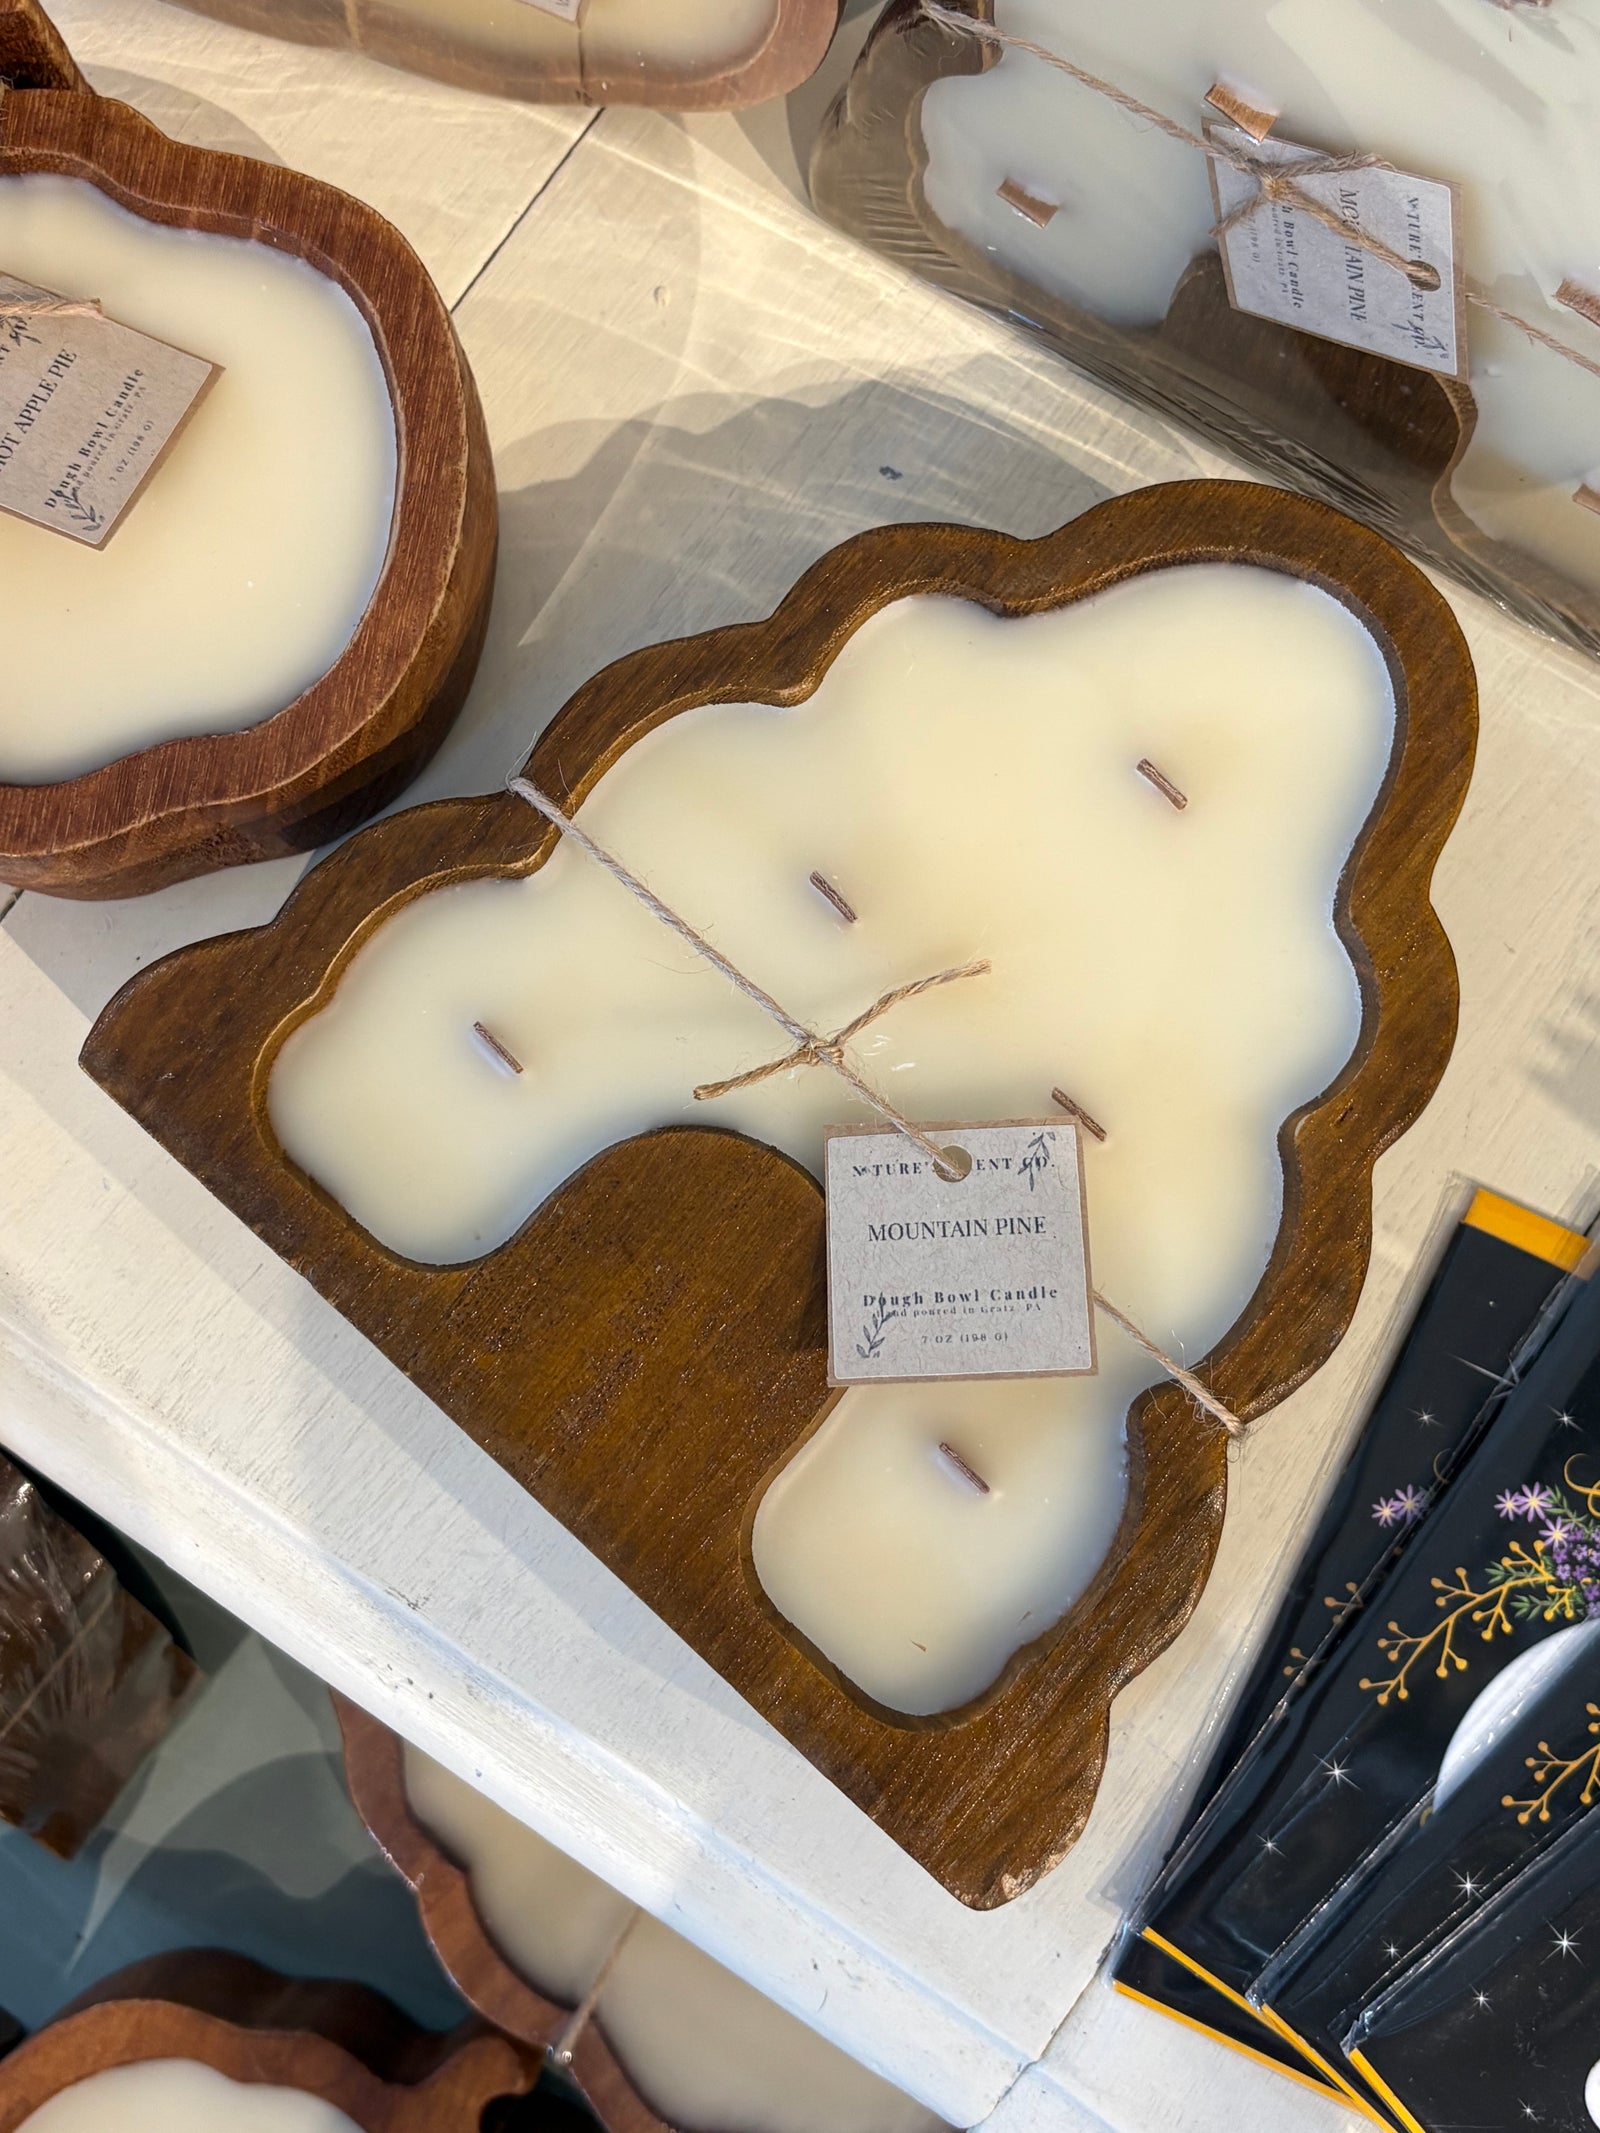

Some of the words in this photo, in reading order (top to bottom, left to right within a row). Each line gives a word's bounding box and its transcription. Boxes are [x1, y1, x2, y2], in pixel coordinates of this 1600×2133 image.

[1288, 262, 1305, 308] Candle
[1348, 285, 1367, 323] PINE
[14, 378, 58, 434] APPLE
[47, 348, 78, 379] PIE
[78, 422, 108, 457] Bowl
[104, 369, 144, 417] Candle
[867, 1218, 988, 1242] MOUNTAIN
[994, 1216, 1047, 1236] PINE
[863, 1291, 924, 1308] Dough
[934, 1288, 979, 1304] Bowl
[990, 1285, 1058, 1301] Candle
[913, 1306, 956, 1318] poured
[963, 1305, 975, 1314] in
[1026, 1303, 1041, 1312] PA
[921, 1335, 928, 1344] 7
[935, 1334, 953, 1344] OZ
[960, 1333, 987, 1343] (198
